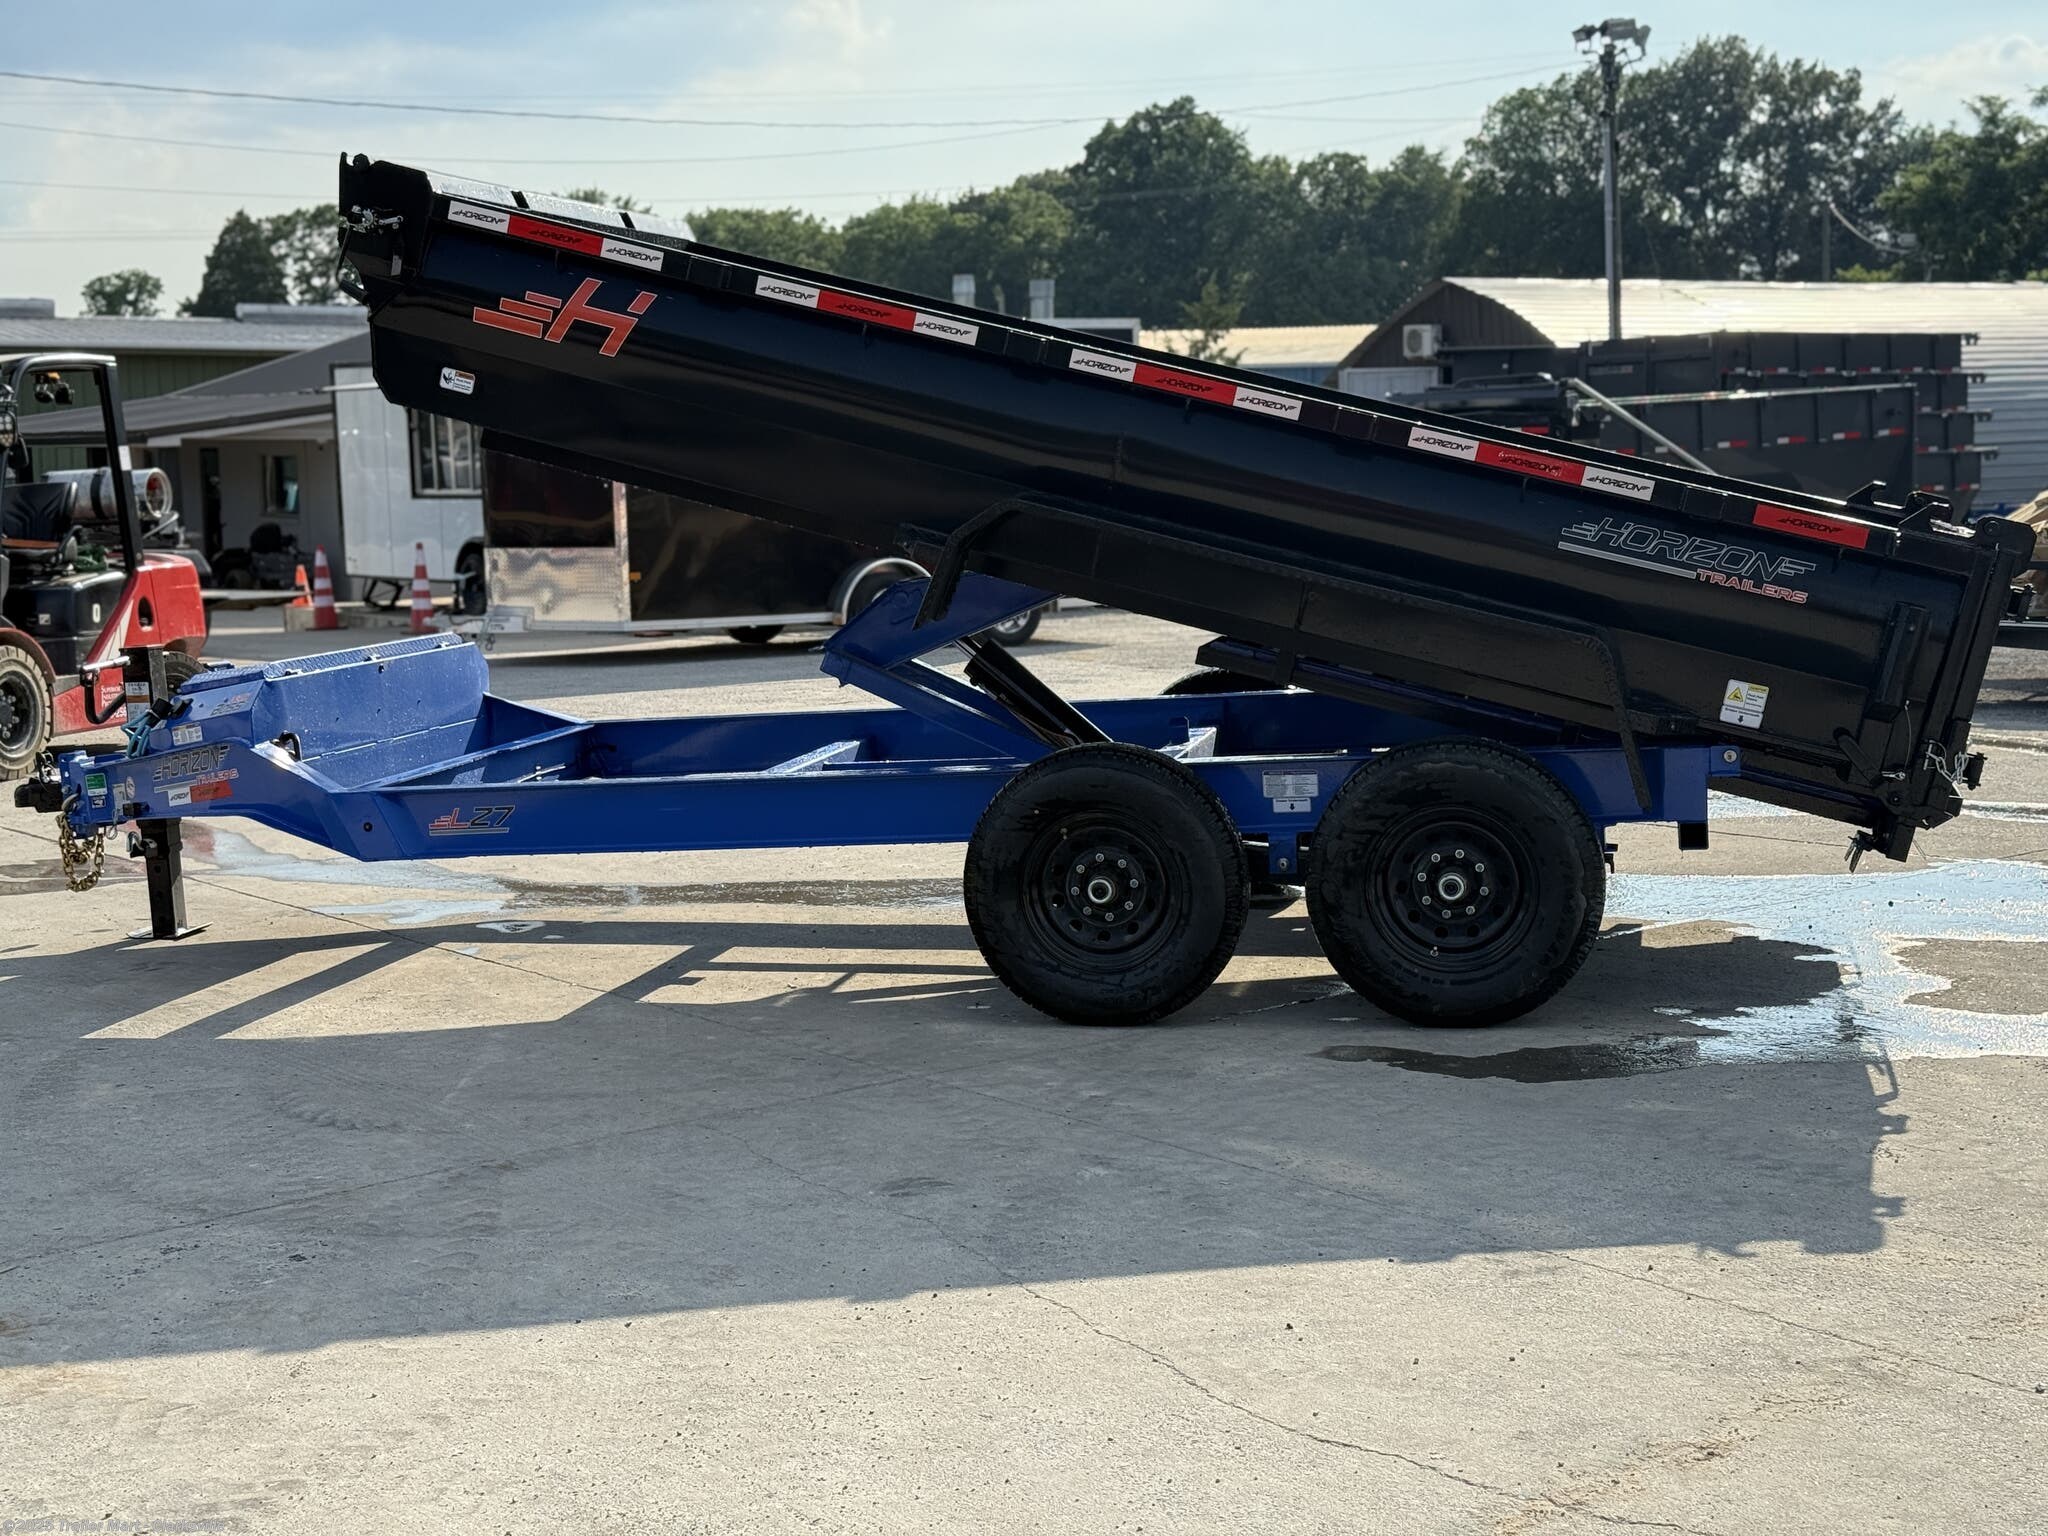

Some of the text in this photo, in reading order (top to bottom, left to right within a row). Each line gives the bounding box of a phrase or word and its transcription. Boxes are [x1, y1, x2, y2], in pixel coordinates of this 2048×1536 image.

[454, 209, 504, 225] HORIZON
[609, 246, 659, 262] HORIZON
[762, 285, 813, 300] HORIZON
[839, 303, 889, 318] HORIZON
[918, 321, 969, 336] HORIZON
[1076, 358, 1128, 374] HORIZON
[1158, 377, 1210, 392] HORIZON
[1240, 396, 1294, 411] HORIZON
[1416, 436, 1470, 451] HORIZON
[1589, 476, 1647, 492] HORIZON
[1780, 517, 1840, 533] HORIZON
[1575, 517, 1802, 581] HORIZON
[1697, 568, 1808, 603] TRAILERS
[156, 745, 226, 781] HORIZON
